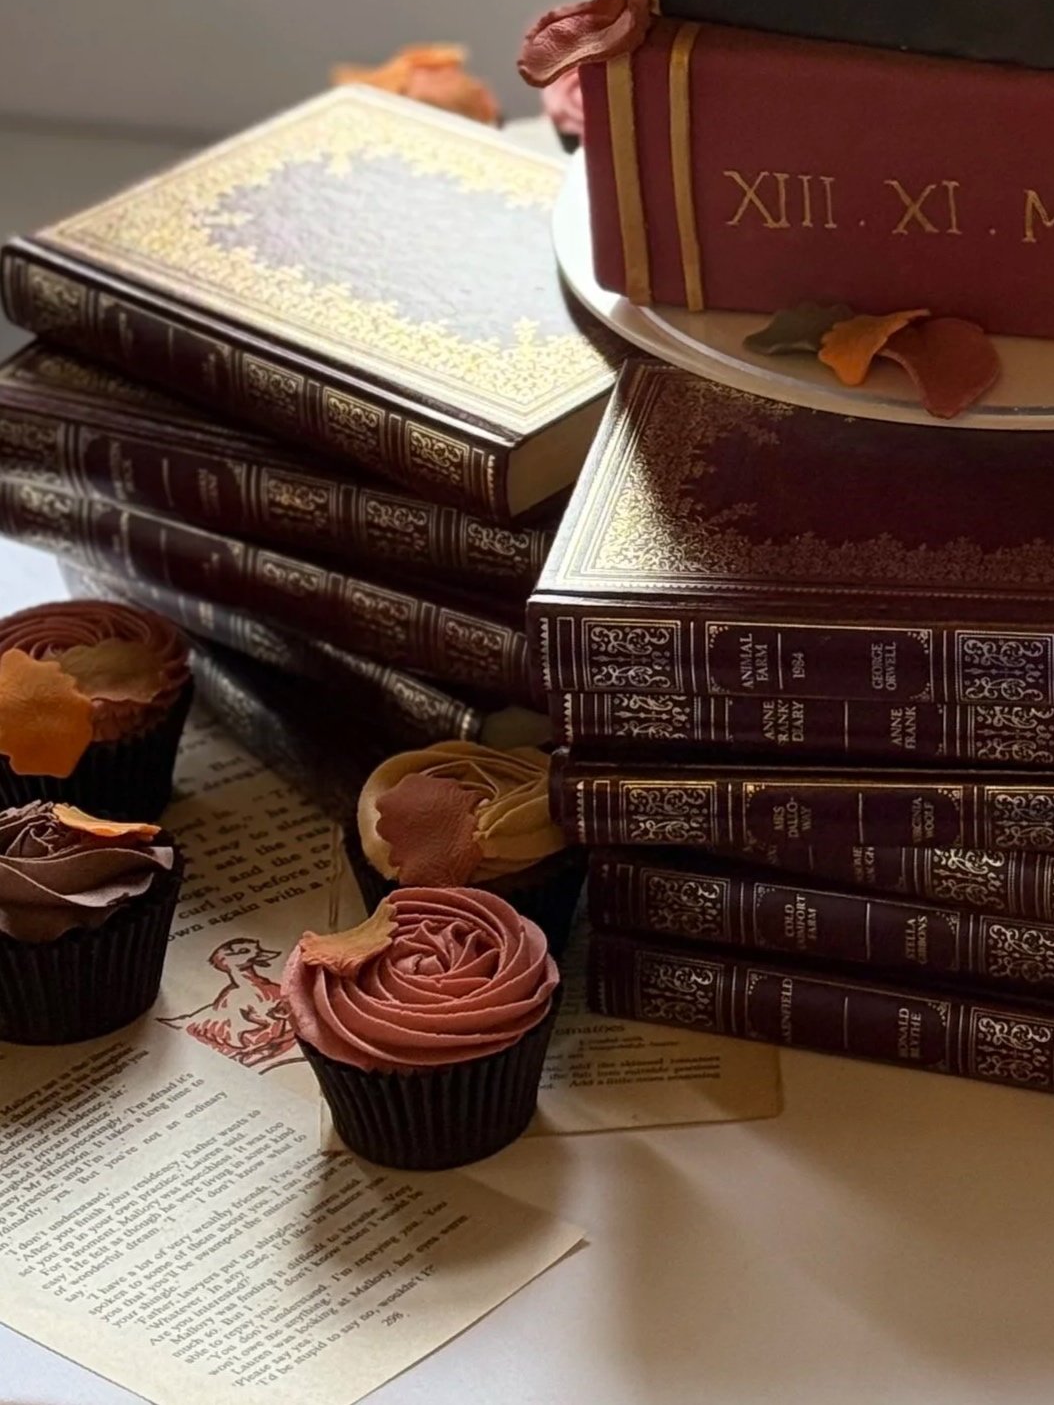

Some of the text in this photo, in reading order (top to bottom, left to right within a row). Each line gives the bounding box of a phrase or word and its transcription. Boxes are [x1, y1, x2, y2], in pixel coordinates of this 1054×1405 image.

[723, 171, 838, 229] XIII
[884, 179, 963, 236] XI
[740, 632, 754, 689] ANIMAL
[756, 643, 769, 682] FARM
[792, 651, 805, 679] 1984
[871, 642, 884, 690] GEORGE
[885, 641, 897, 692] ORWELL
[763, 700, 776, 741] ANNE
[791, 700, 805, 742] DIARY
[890, 708, 904, 746] ANNE
[904, 706, 918, 750] FRANK
[203, 830, 269, 857] way to
[214, 854, 247, 871] ask
[254, 841, 286, 856] the
[228, 853, 302, 884] and the
[177, 868, 310, 920] curl up before
[207, 903, 260, 926] again
[263, 886, 306, 904] with
[308, 881, 323, 890] a
[784, 903, 795, 937] COLD
[99, 1306, 123, 1323] you
[122, 1290, 147, 1307] that
[175, 1260, 195, 1272] be
[194, 1227, 243, 1261] swamped
[241, 1216, 262, 1230] the
[262, 1193, 298, 1217] minute
[176, 1271, 220, 1299] lawyers
[219, 1258, 240, 1274] put
[238, 1248, 255, 1260] up
[111, 1309, 138, 1329] your
[184, 1347, 209, 1364] able
[207, 1338, 224, 1349] to
[222, 1318, 255, 1340] repay
[240, 1340, 265, 1357] owe
[263, 1328, 284, 1341] me
[271, 1350, 292, 1365] say
[274, 1363, 294, 1375] be
[293, 1340, 328, 1365] stupid
[325, 1332, 341, 1342] to
[339, 1319, 360, 1334] say
